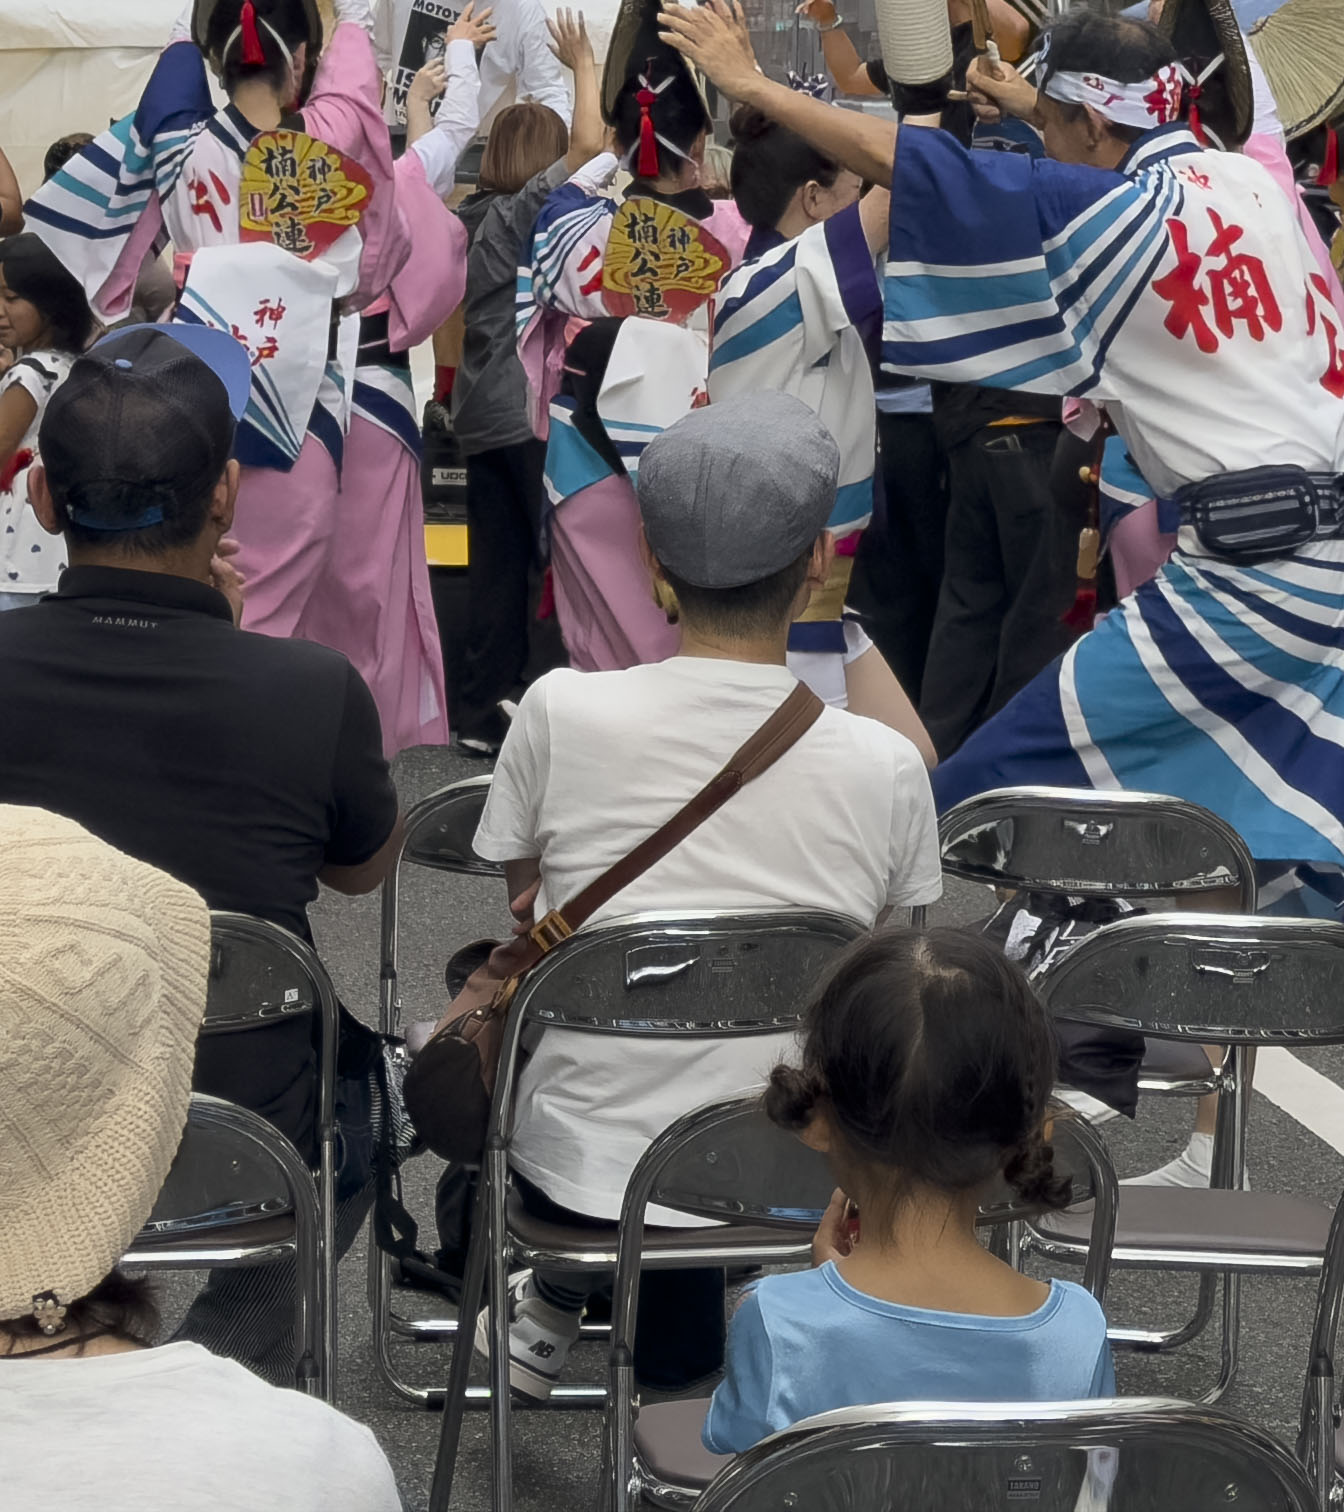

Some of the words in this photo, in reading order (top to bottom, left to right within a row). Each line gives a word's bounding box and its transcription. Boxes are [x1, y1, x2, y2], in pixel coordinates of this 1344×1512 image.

[260, 145, 314, 254] 楠公連
[307, 157, 332, 215] 神戸
[624, 212, 671, 318] 楠公連
[667, 226, 691, 279] 神戸
[91, 615, 158, 629] MAMMUT
